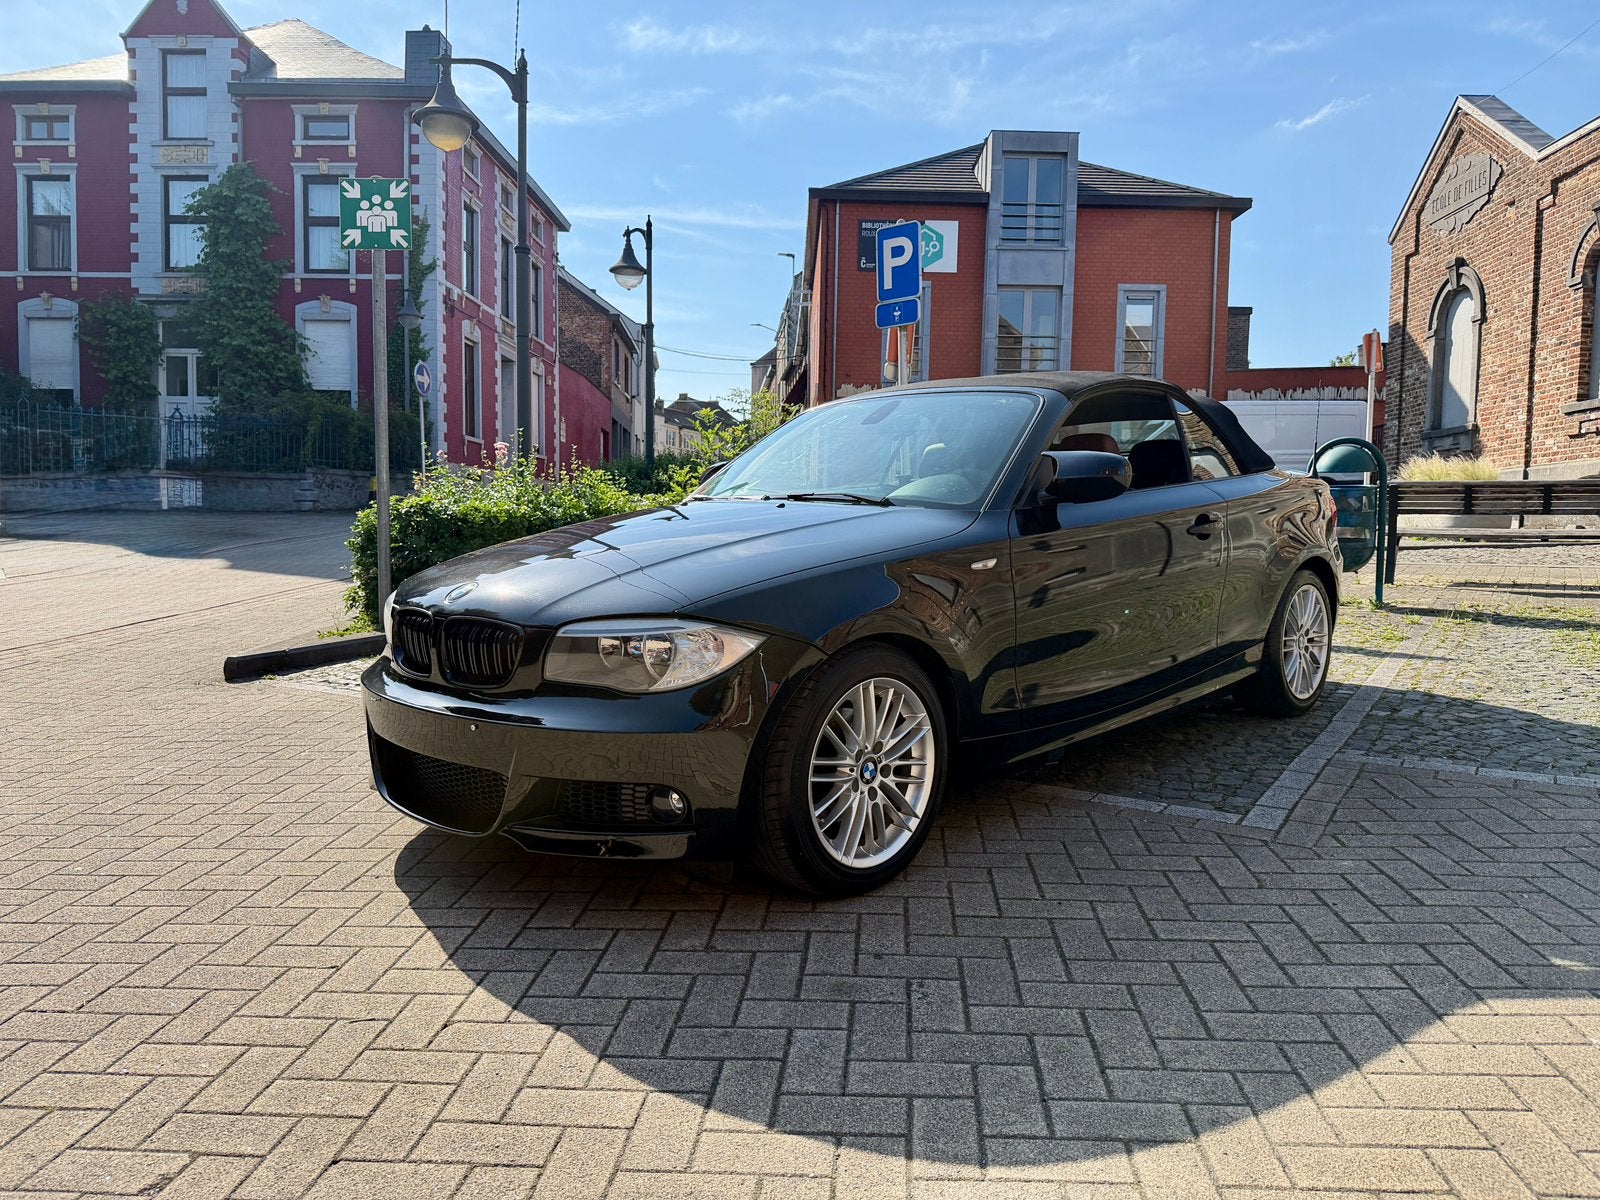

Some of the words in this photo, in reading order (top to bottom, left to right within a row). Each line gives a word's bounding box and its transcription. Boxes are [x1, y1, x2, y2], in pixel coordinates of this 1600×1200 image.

[1453, 184, 1462, 203] DE
[1464, 169, 1487, 197] FILLES
[883, 236, 913, 290] P
